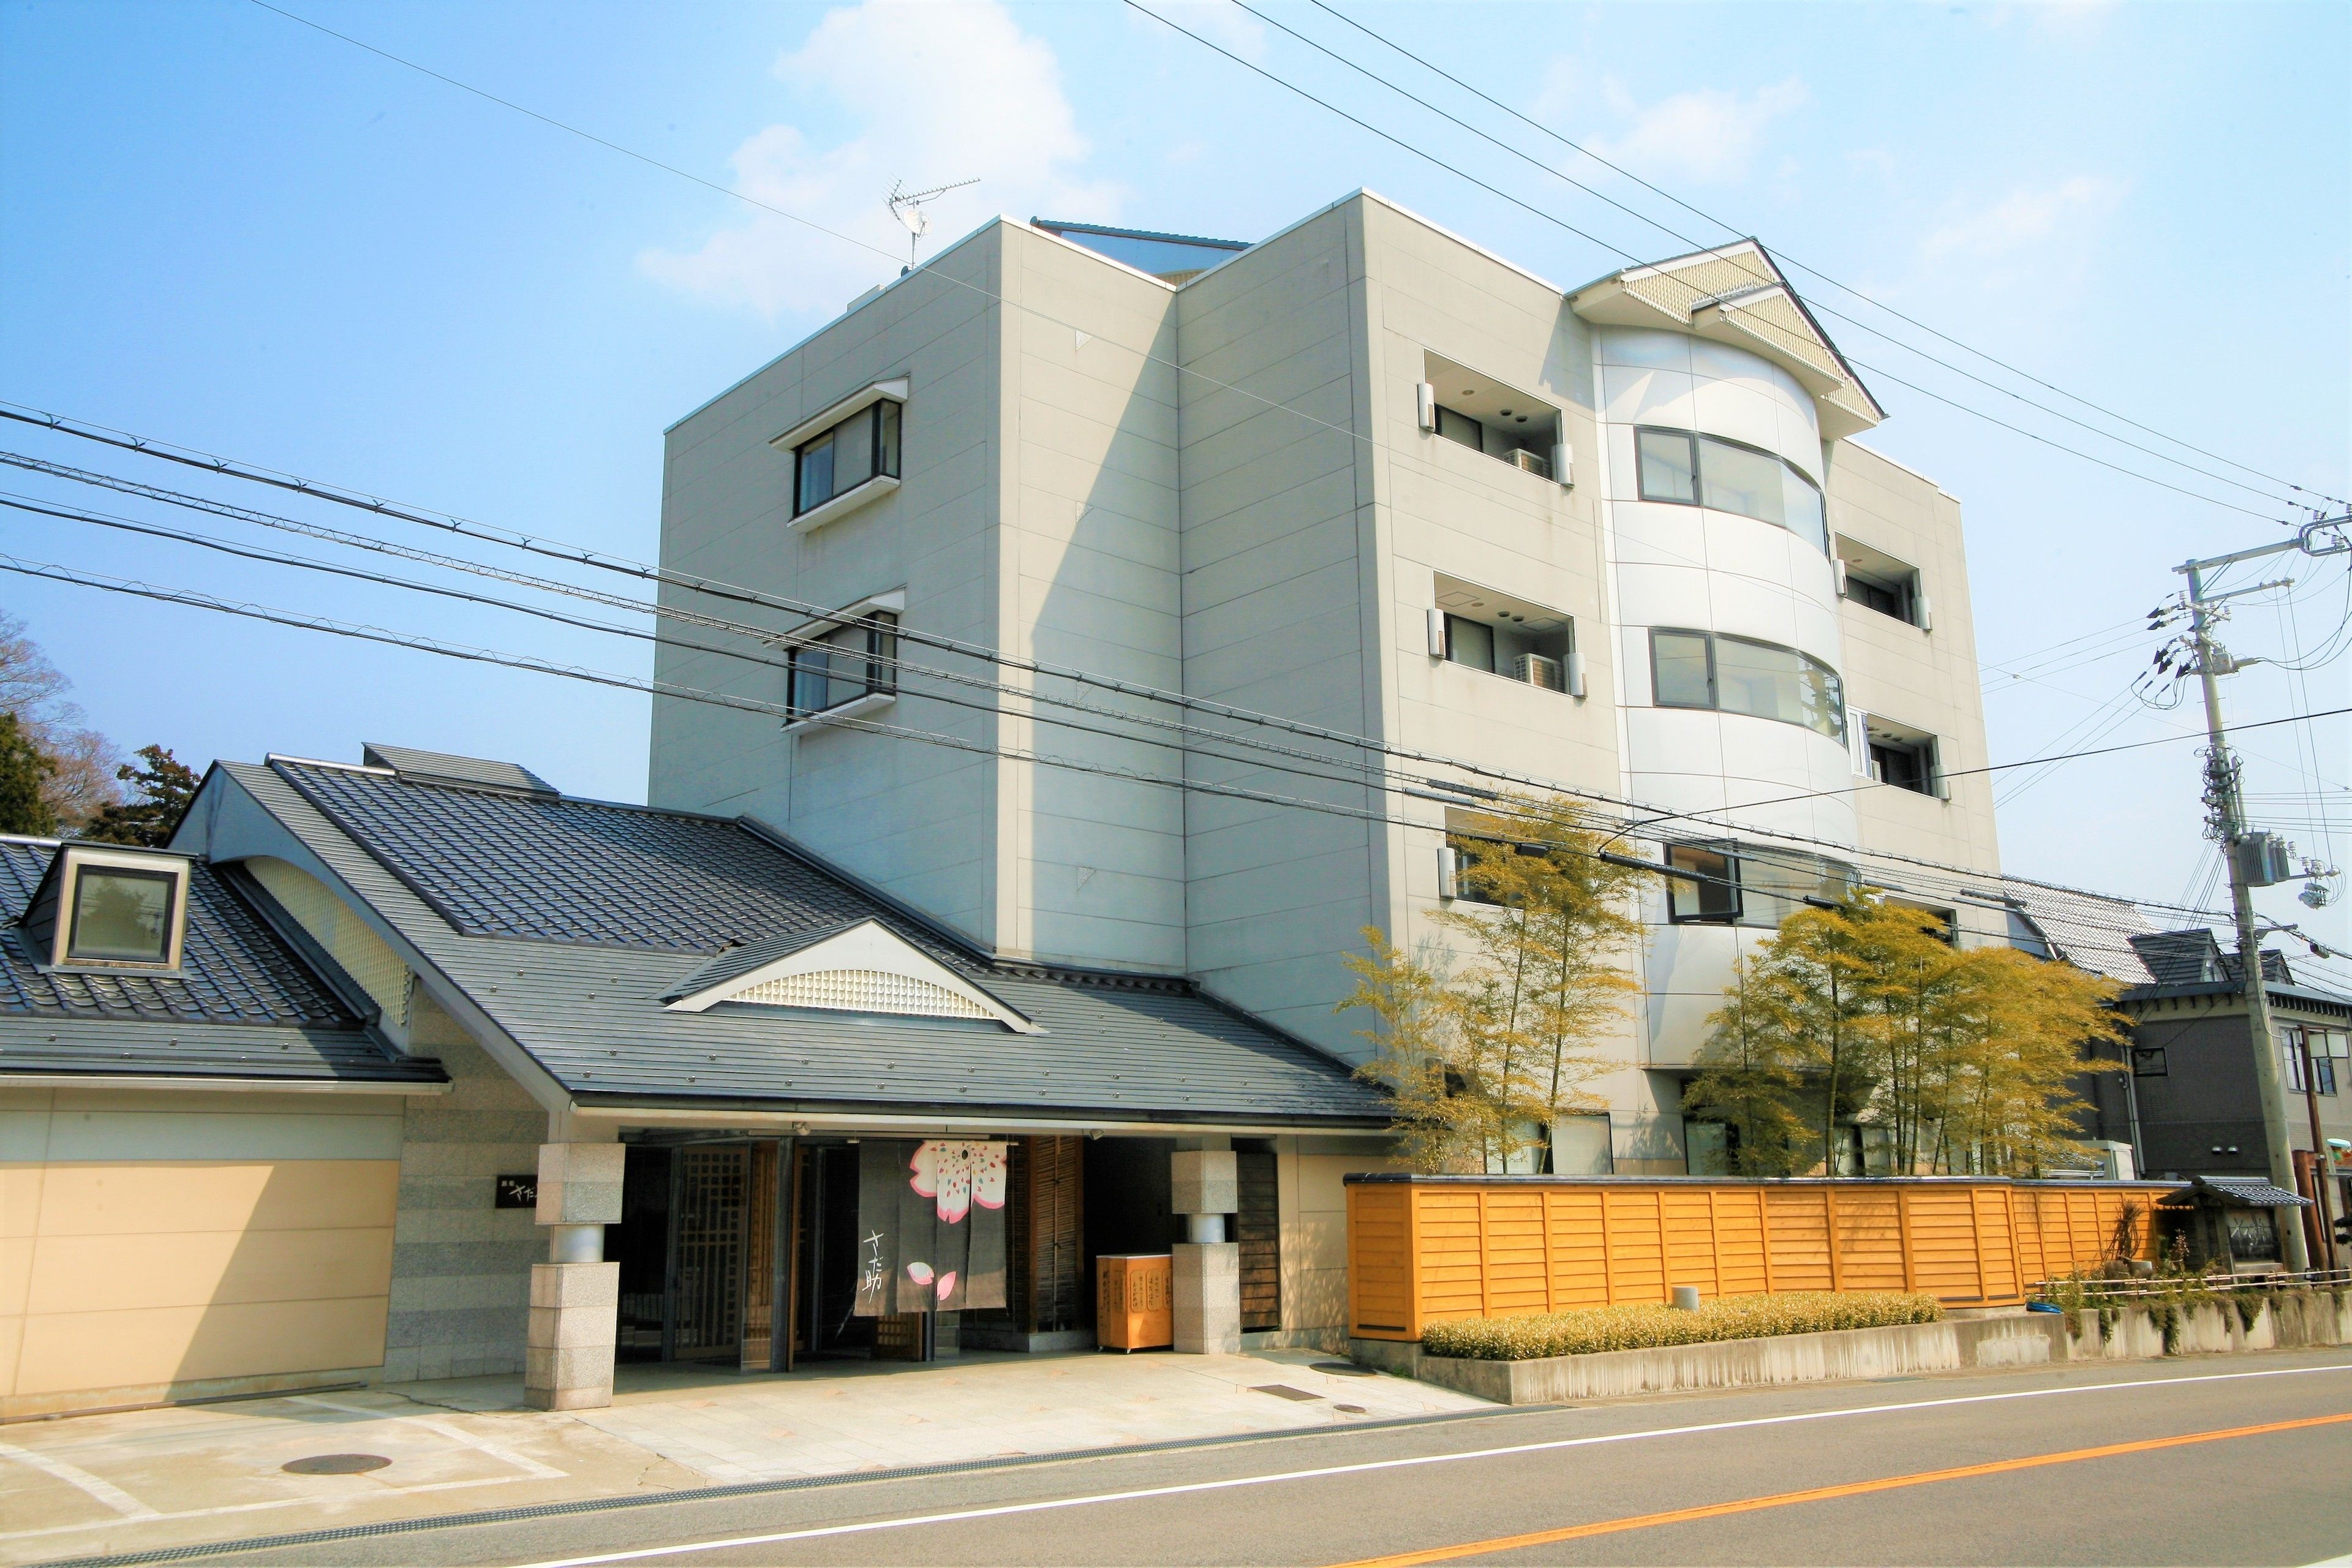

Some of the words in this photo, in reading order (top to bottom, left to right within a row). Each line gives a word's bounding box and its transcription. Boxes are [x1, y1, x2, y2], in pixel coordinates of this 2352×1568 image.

[508, 1185, 538, 1202] さだ
[862, 1229, 884, 1304] さだ助
